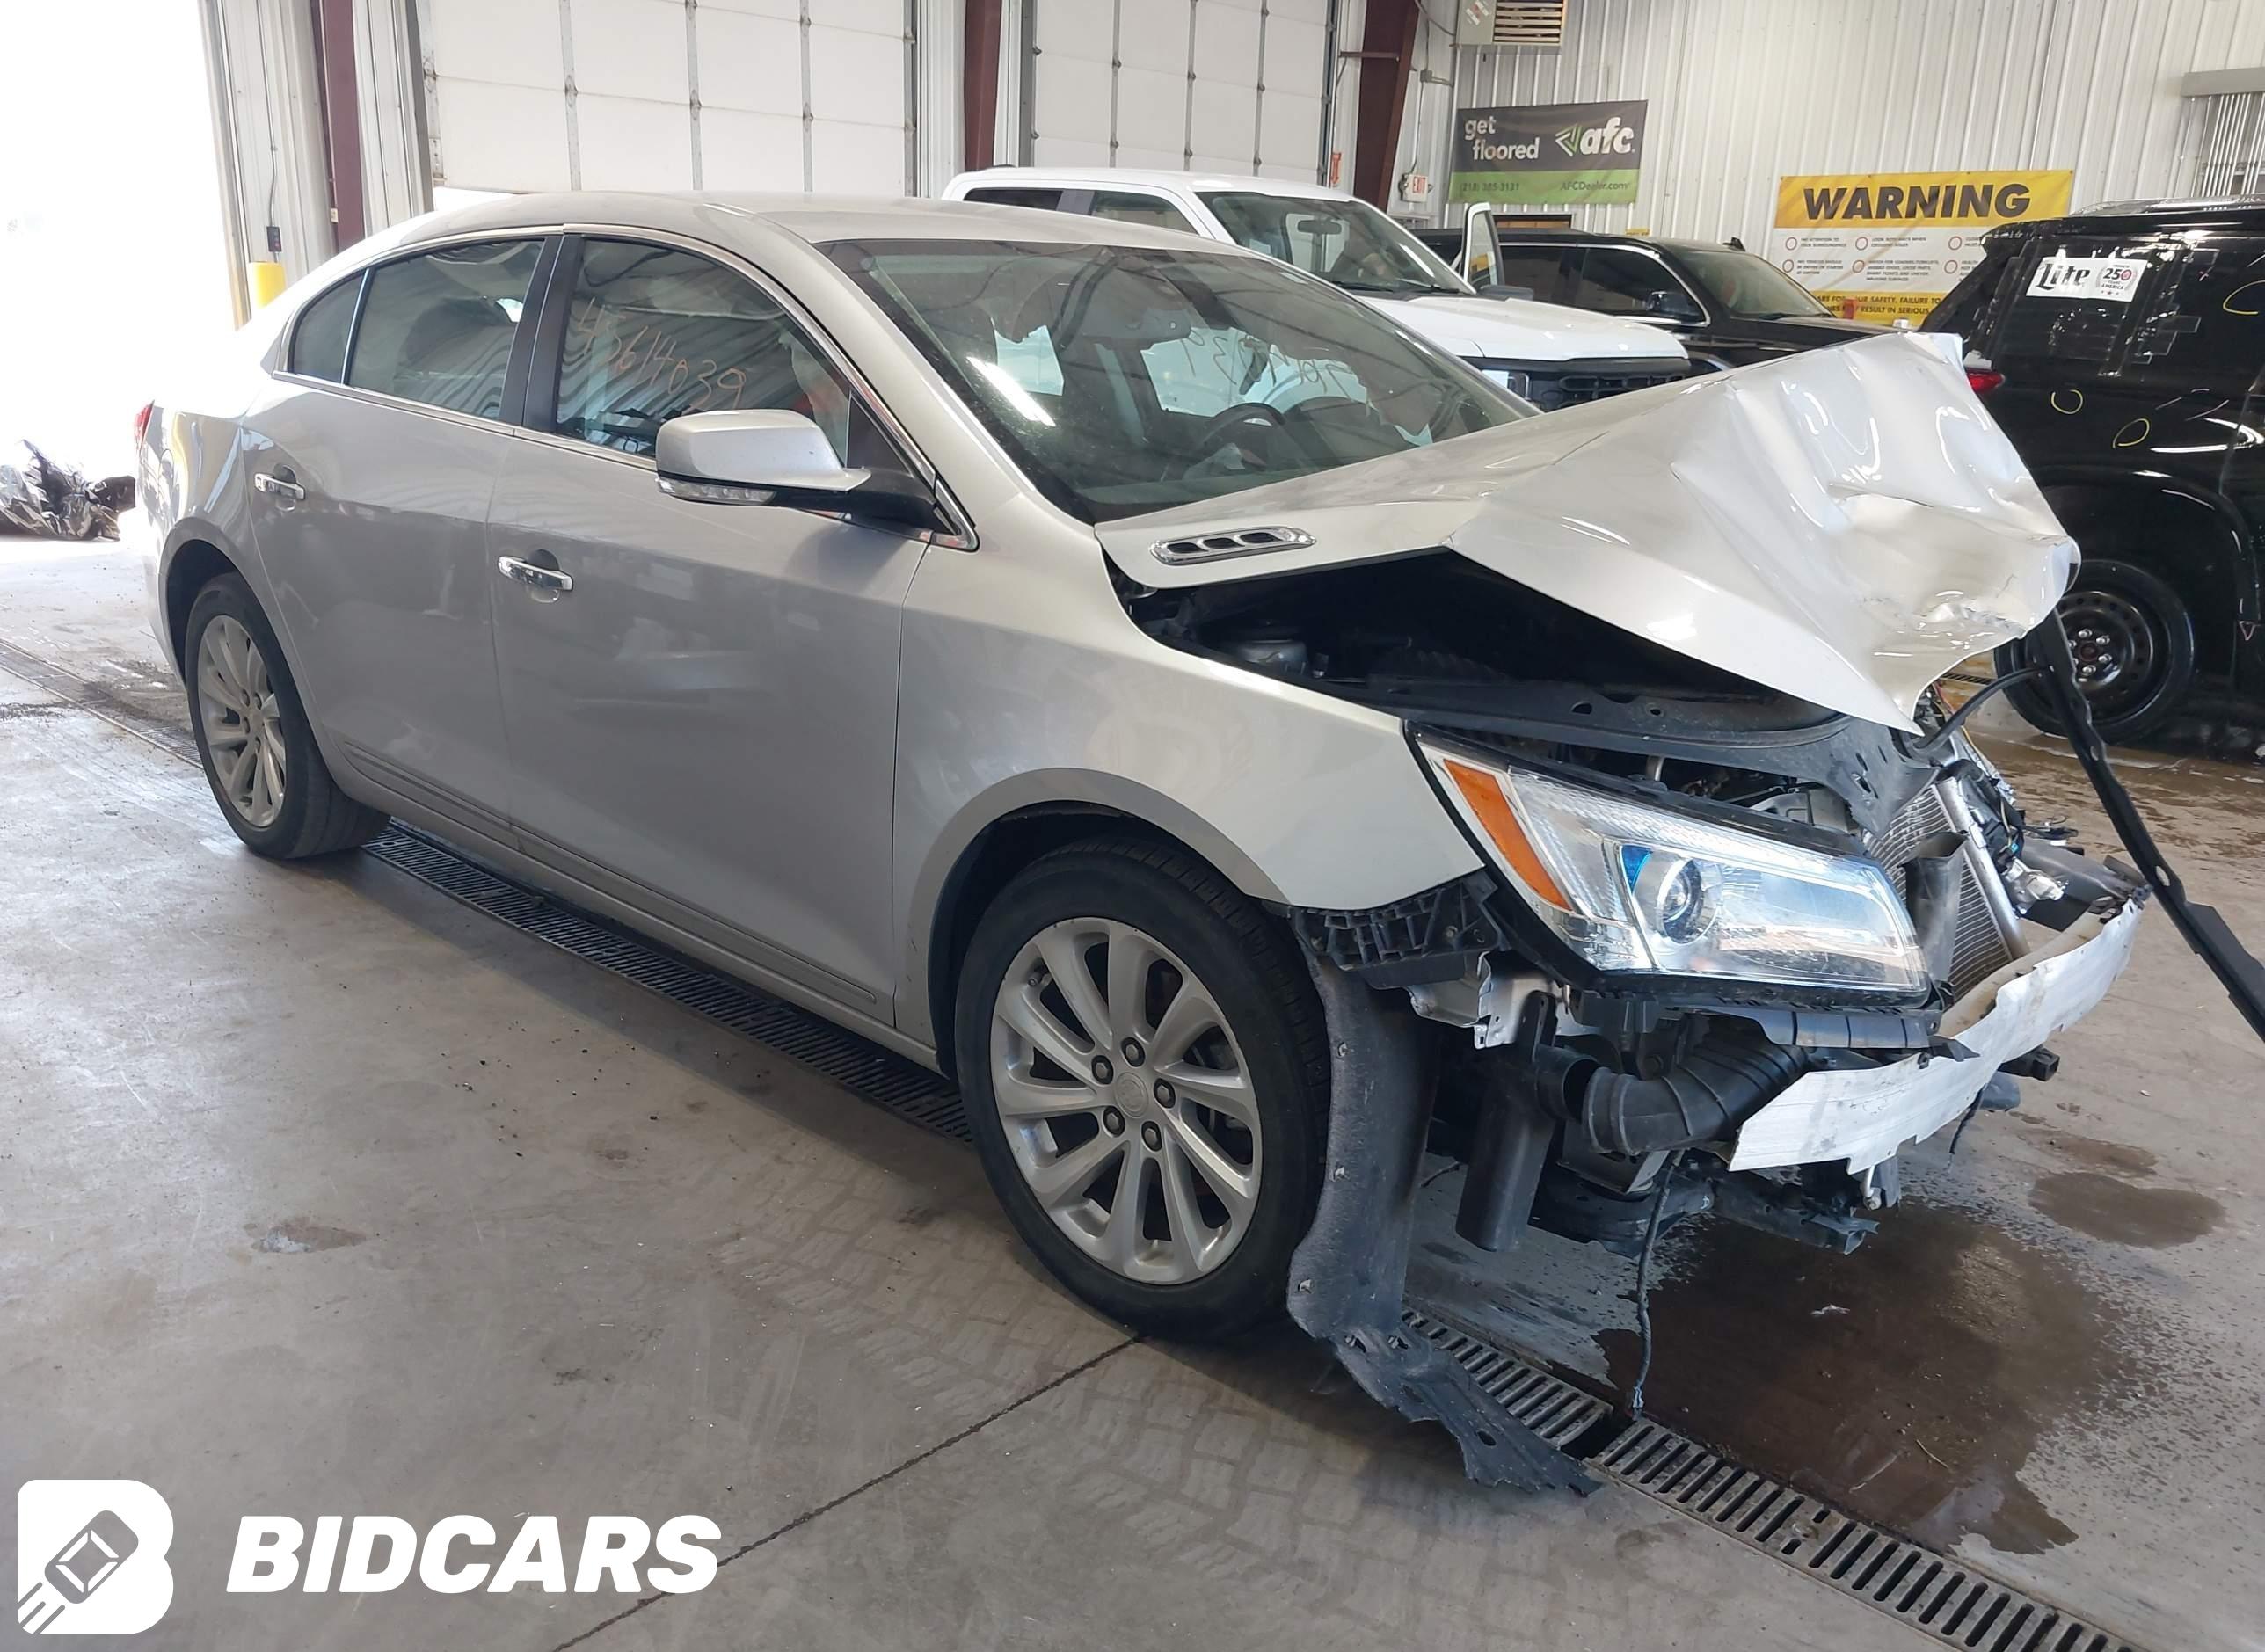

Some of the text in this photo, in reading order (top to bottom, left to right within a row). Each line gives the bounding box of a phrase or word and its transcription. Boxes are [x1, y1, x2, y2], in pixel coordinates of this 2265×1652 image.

[1465, 116, 1497, 140] get
[1580, 117, 1635, 155] afc
[1473, 137, 1540, 160] floored
[1803, 184, 2031, 220] WARNING
[2036, 264, 2090, 290] Lite
[2103, 268, 2132, 280] 250
